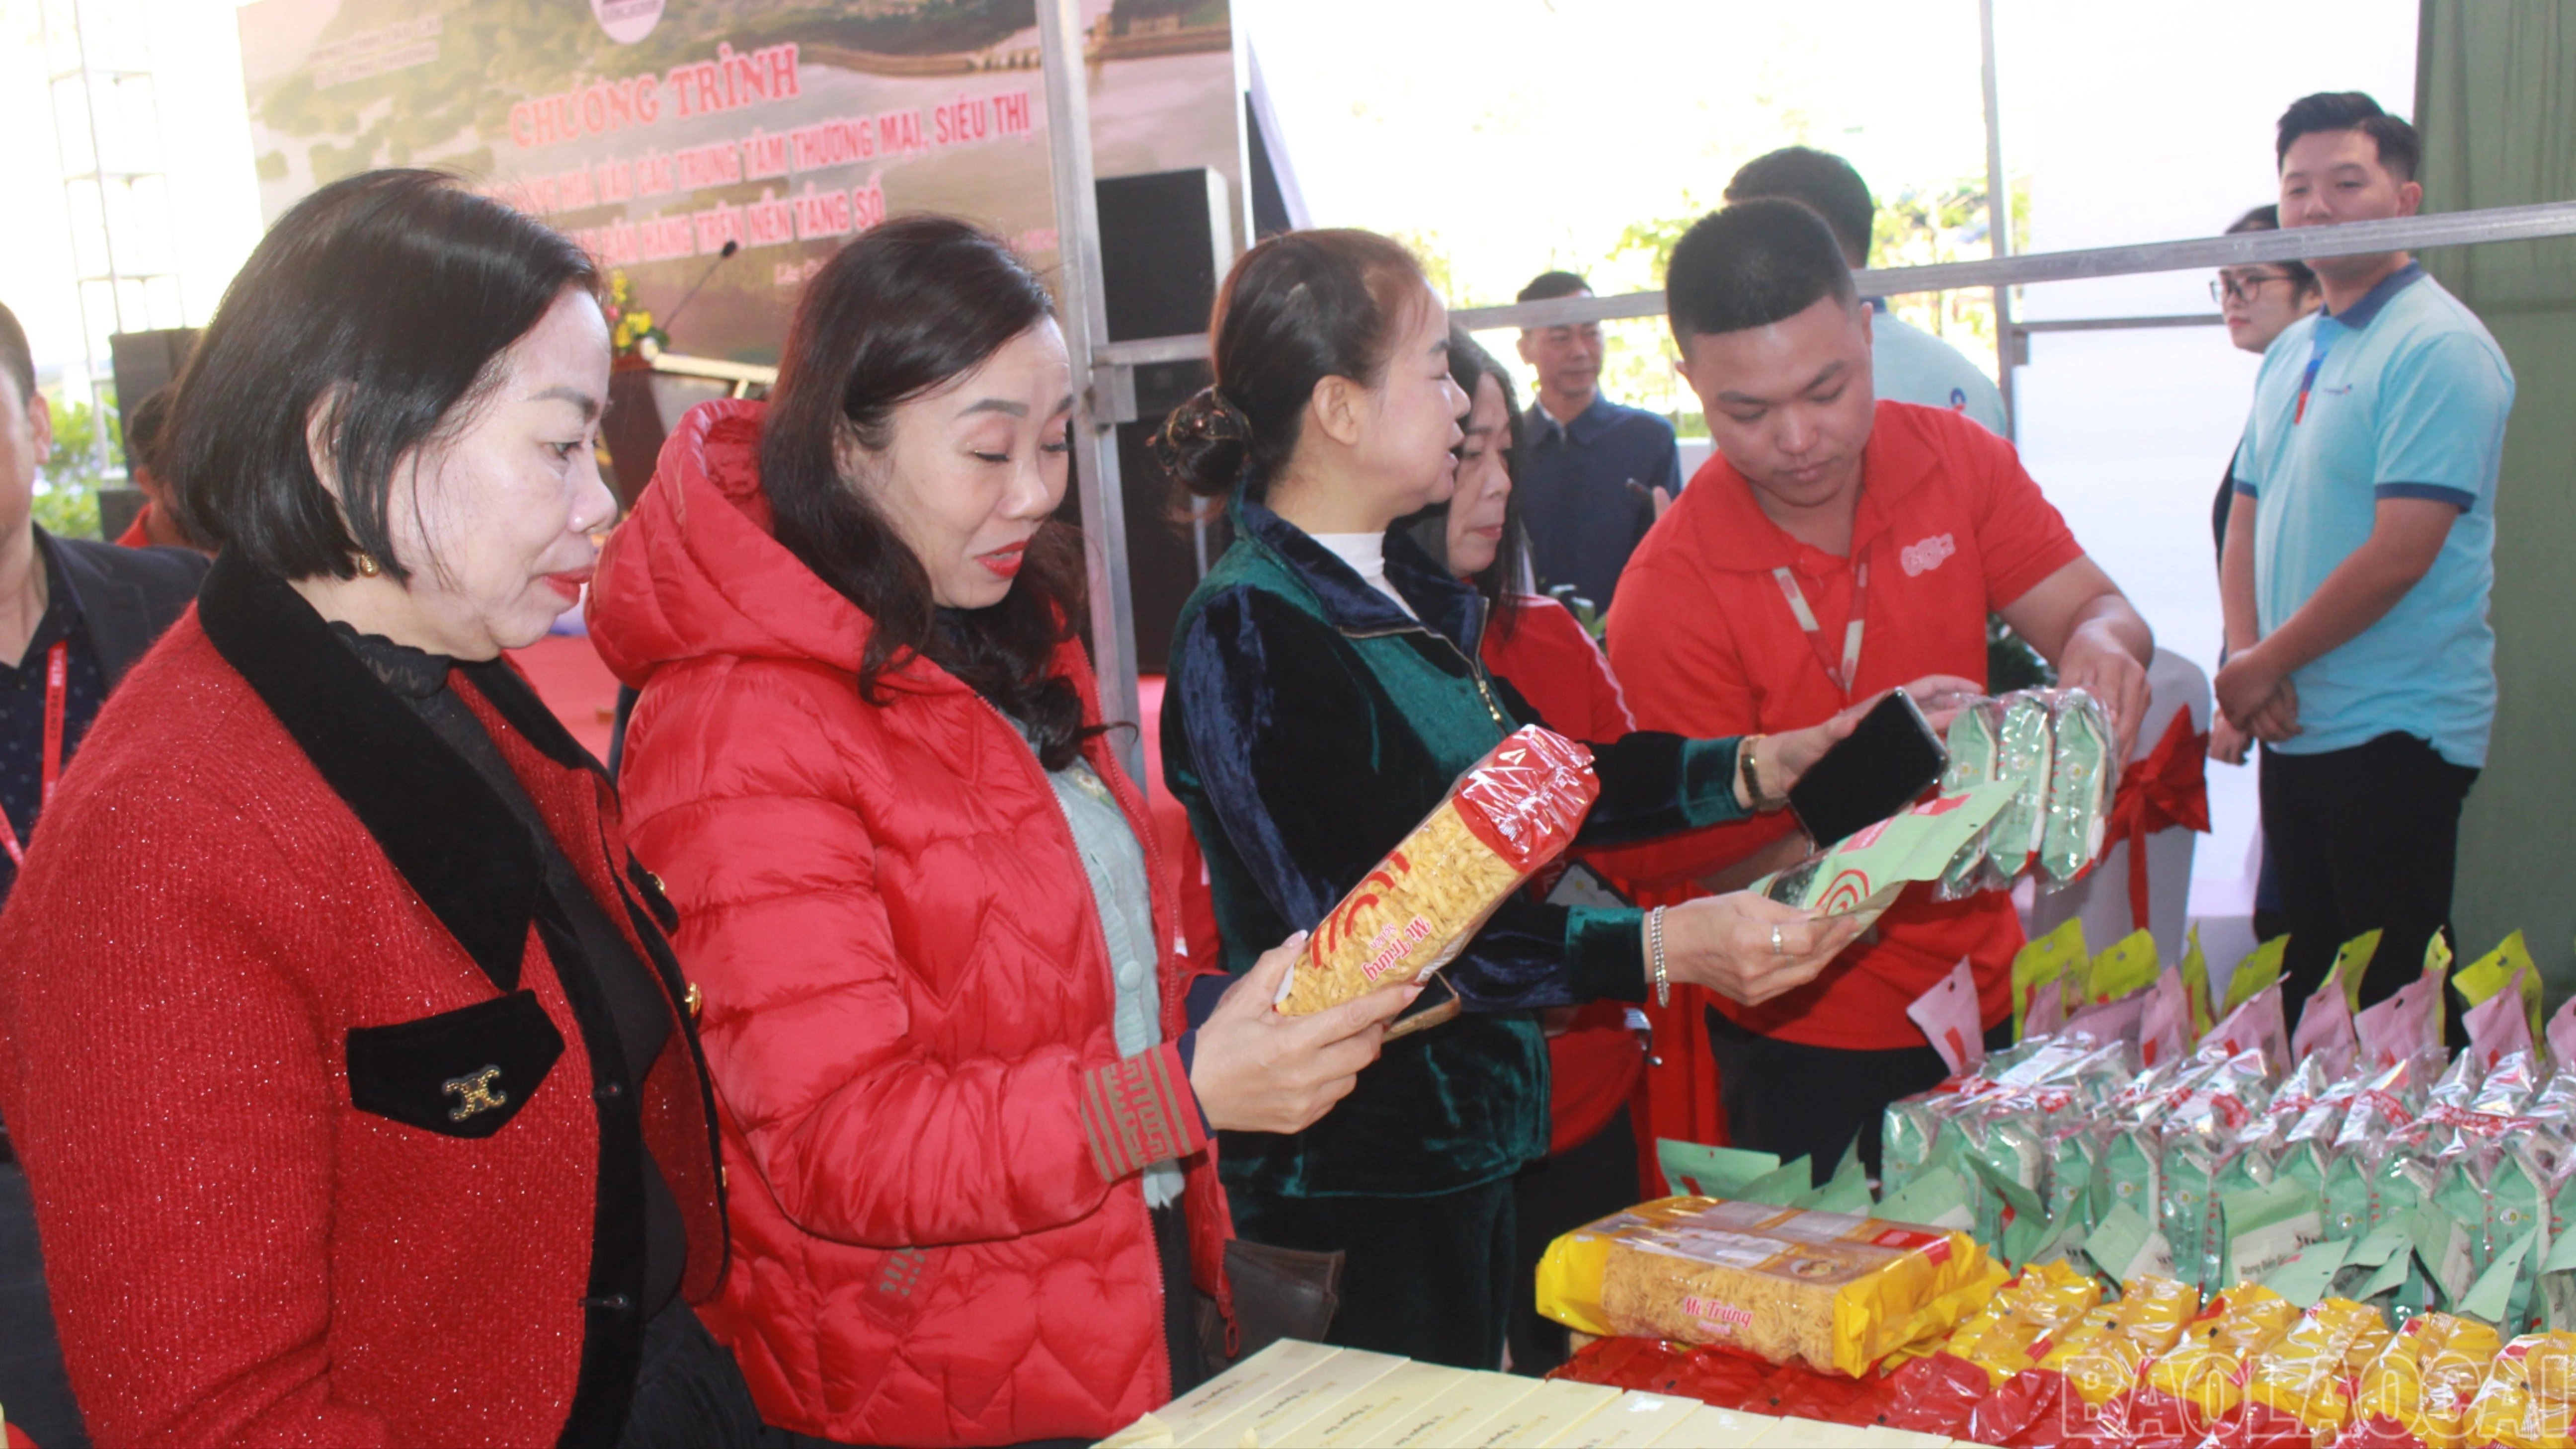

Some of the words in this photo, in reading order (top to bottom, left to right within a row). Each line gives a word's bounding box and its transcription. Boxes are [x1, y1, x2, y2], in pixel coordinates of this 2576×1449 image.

[511, 74, 660, 148] CHƯƠNG
[669, 43, 799, 118] TRÌNH
[675, 140, 741, 191] TRUNG
[741, 127, 788, 181] TÂM
[790, 117, 875, 172] THƯƠNG
[877, 109, 930, 162] MẠI,
[991, 90, 1033, 144] THỊ
[794, 179, 852, 241] TẢNG
[853, 169, 886, 233] SỐ
[1362, 938, 1412, 982] Trứng
